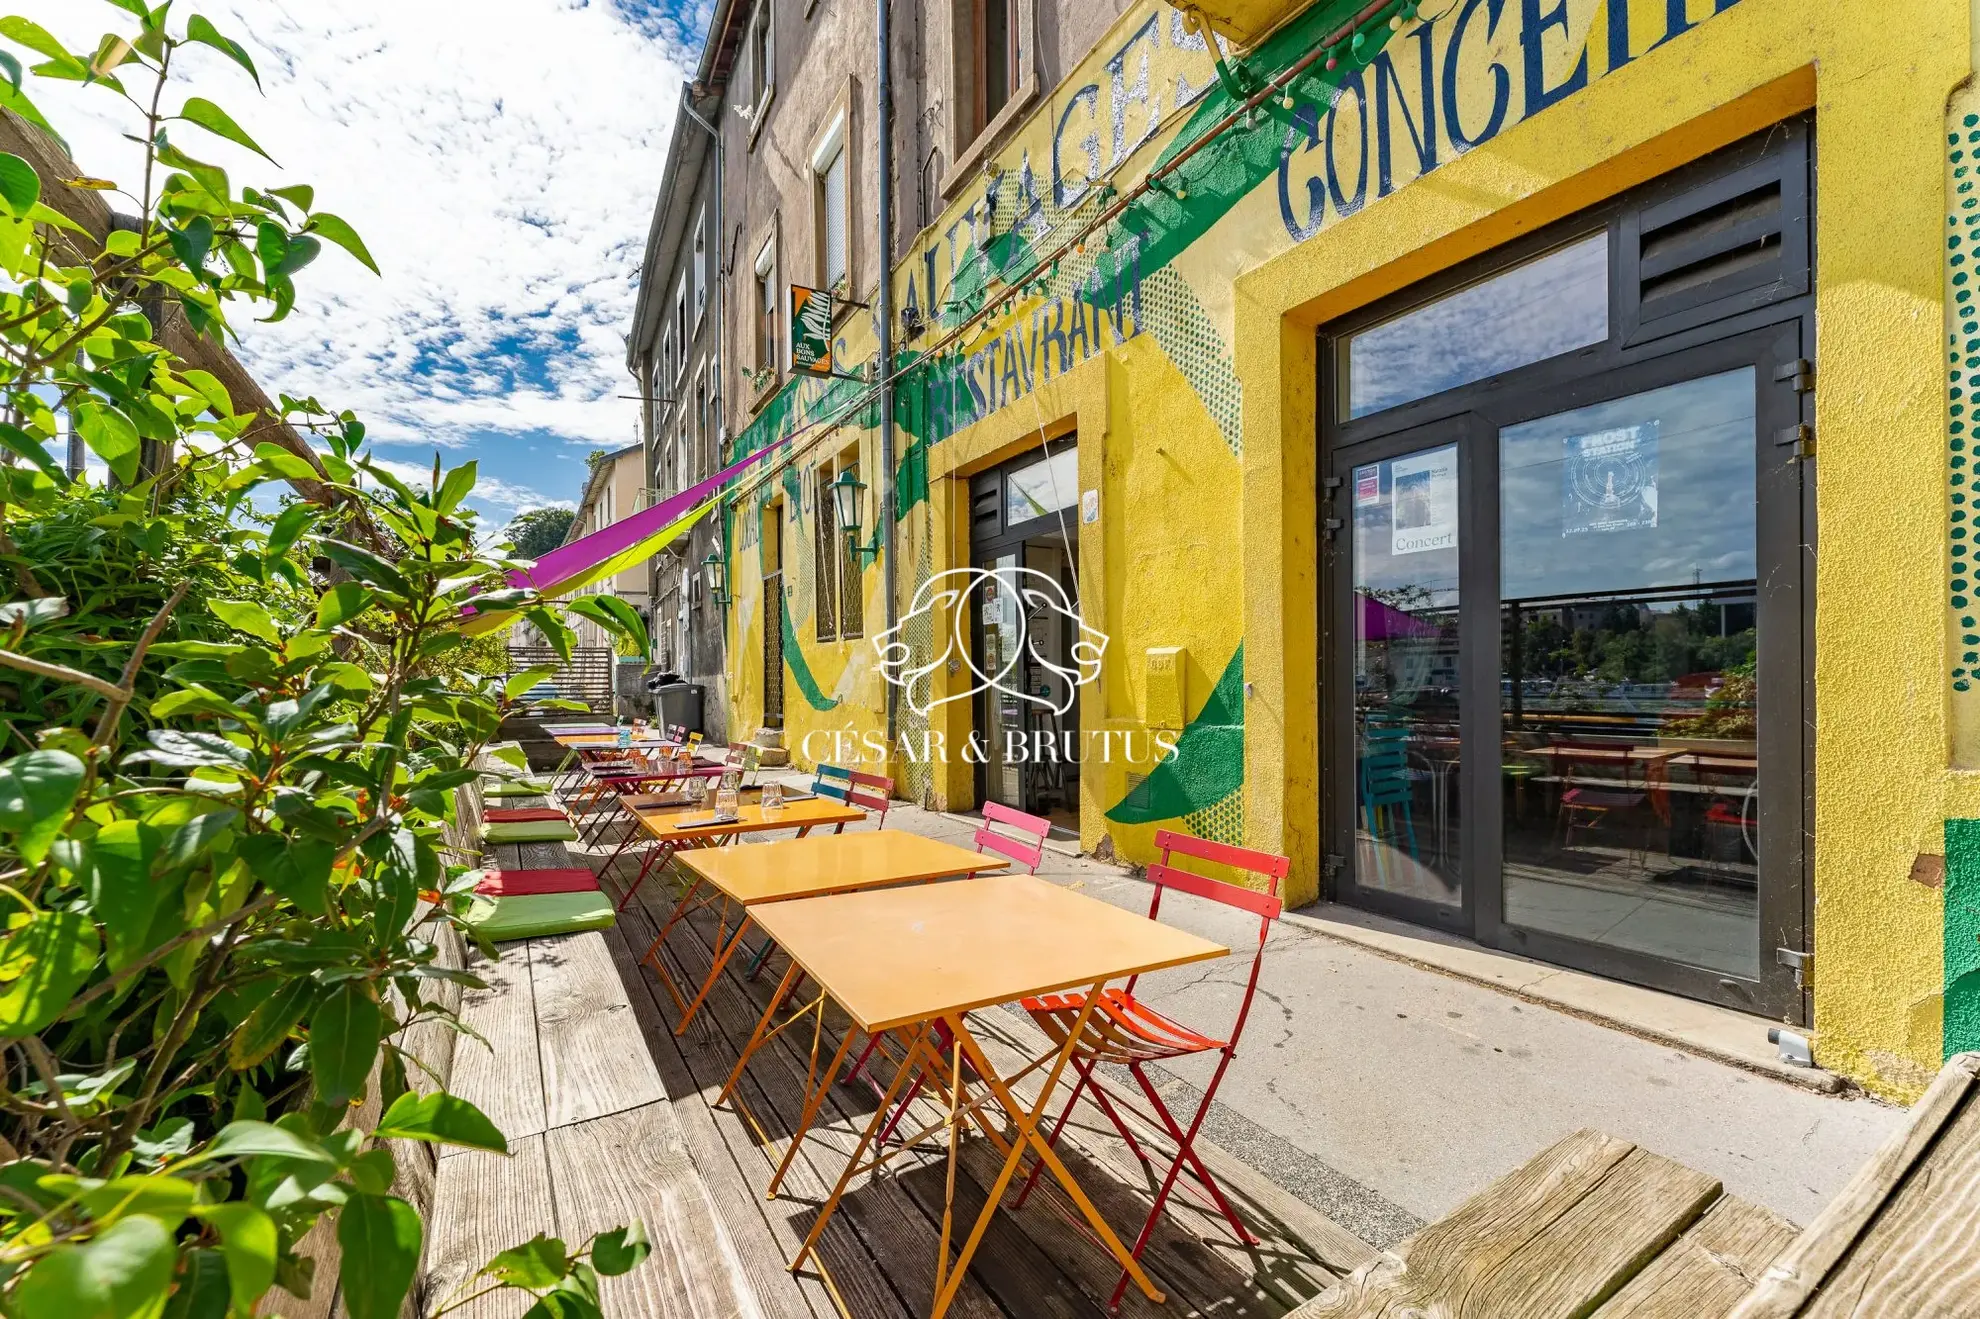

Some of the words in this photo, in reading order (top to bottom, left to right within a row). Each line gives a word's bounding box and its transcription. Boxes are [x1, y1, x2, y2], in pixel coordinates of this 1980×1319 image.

[796, 342, 810, 350] AUX
[796, 347, 815, 357] BONS
[796, 353, 830, 365] SAUVAGES
[1396, 532, 1452, 551] Concert
